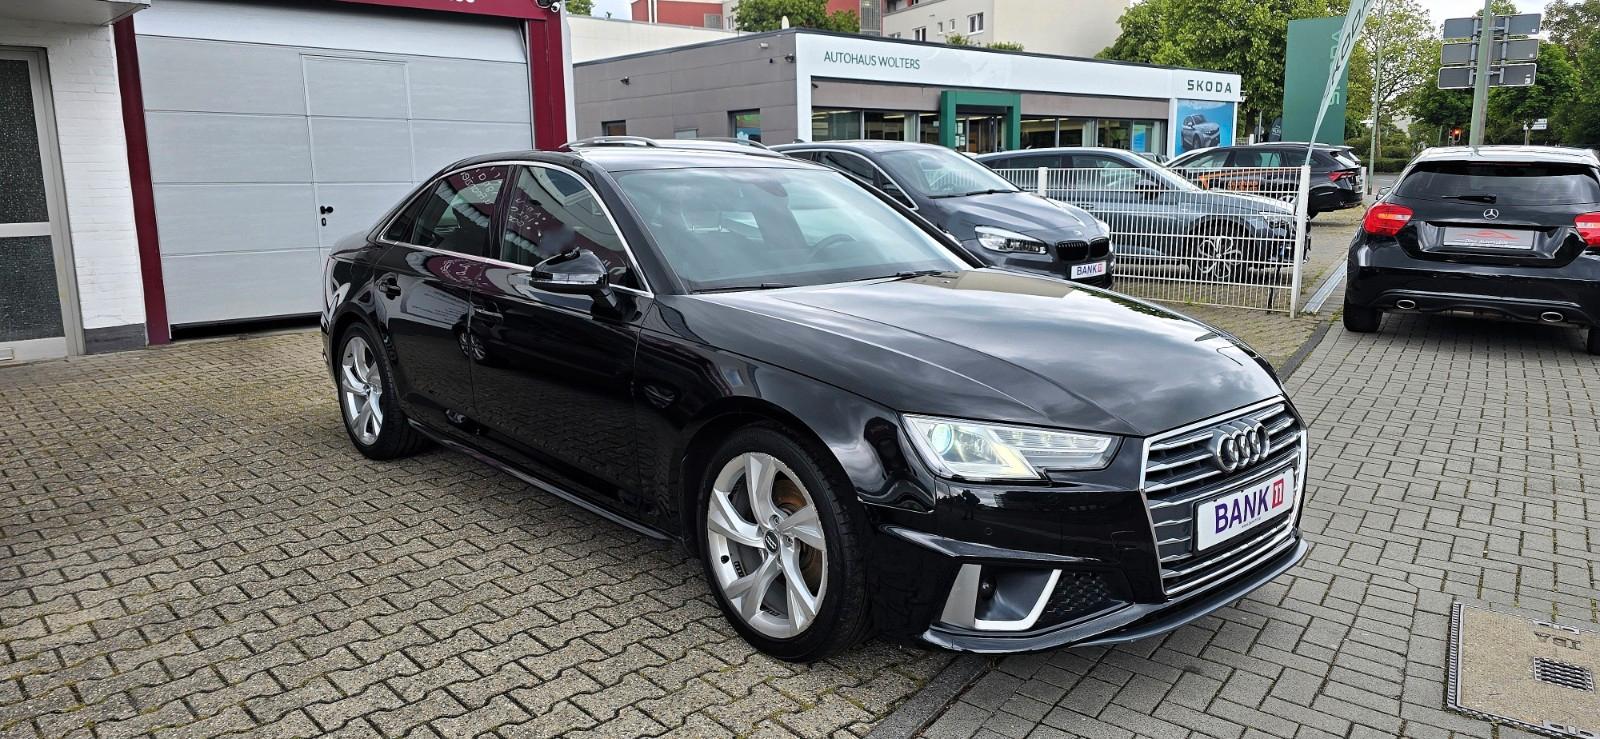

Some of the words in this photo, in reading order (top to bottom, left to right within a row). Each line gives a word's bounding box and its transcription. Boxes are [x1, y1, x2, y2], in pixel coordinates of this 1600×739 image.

[823, 50, 877, 66] AUTOHAUS
[877, 55, 920, 69] WOLTERS
[1076, 264, 1098, 276] BANK
[1215, 485, 1270, 534] BANK
